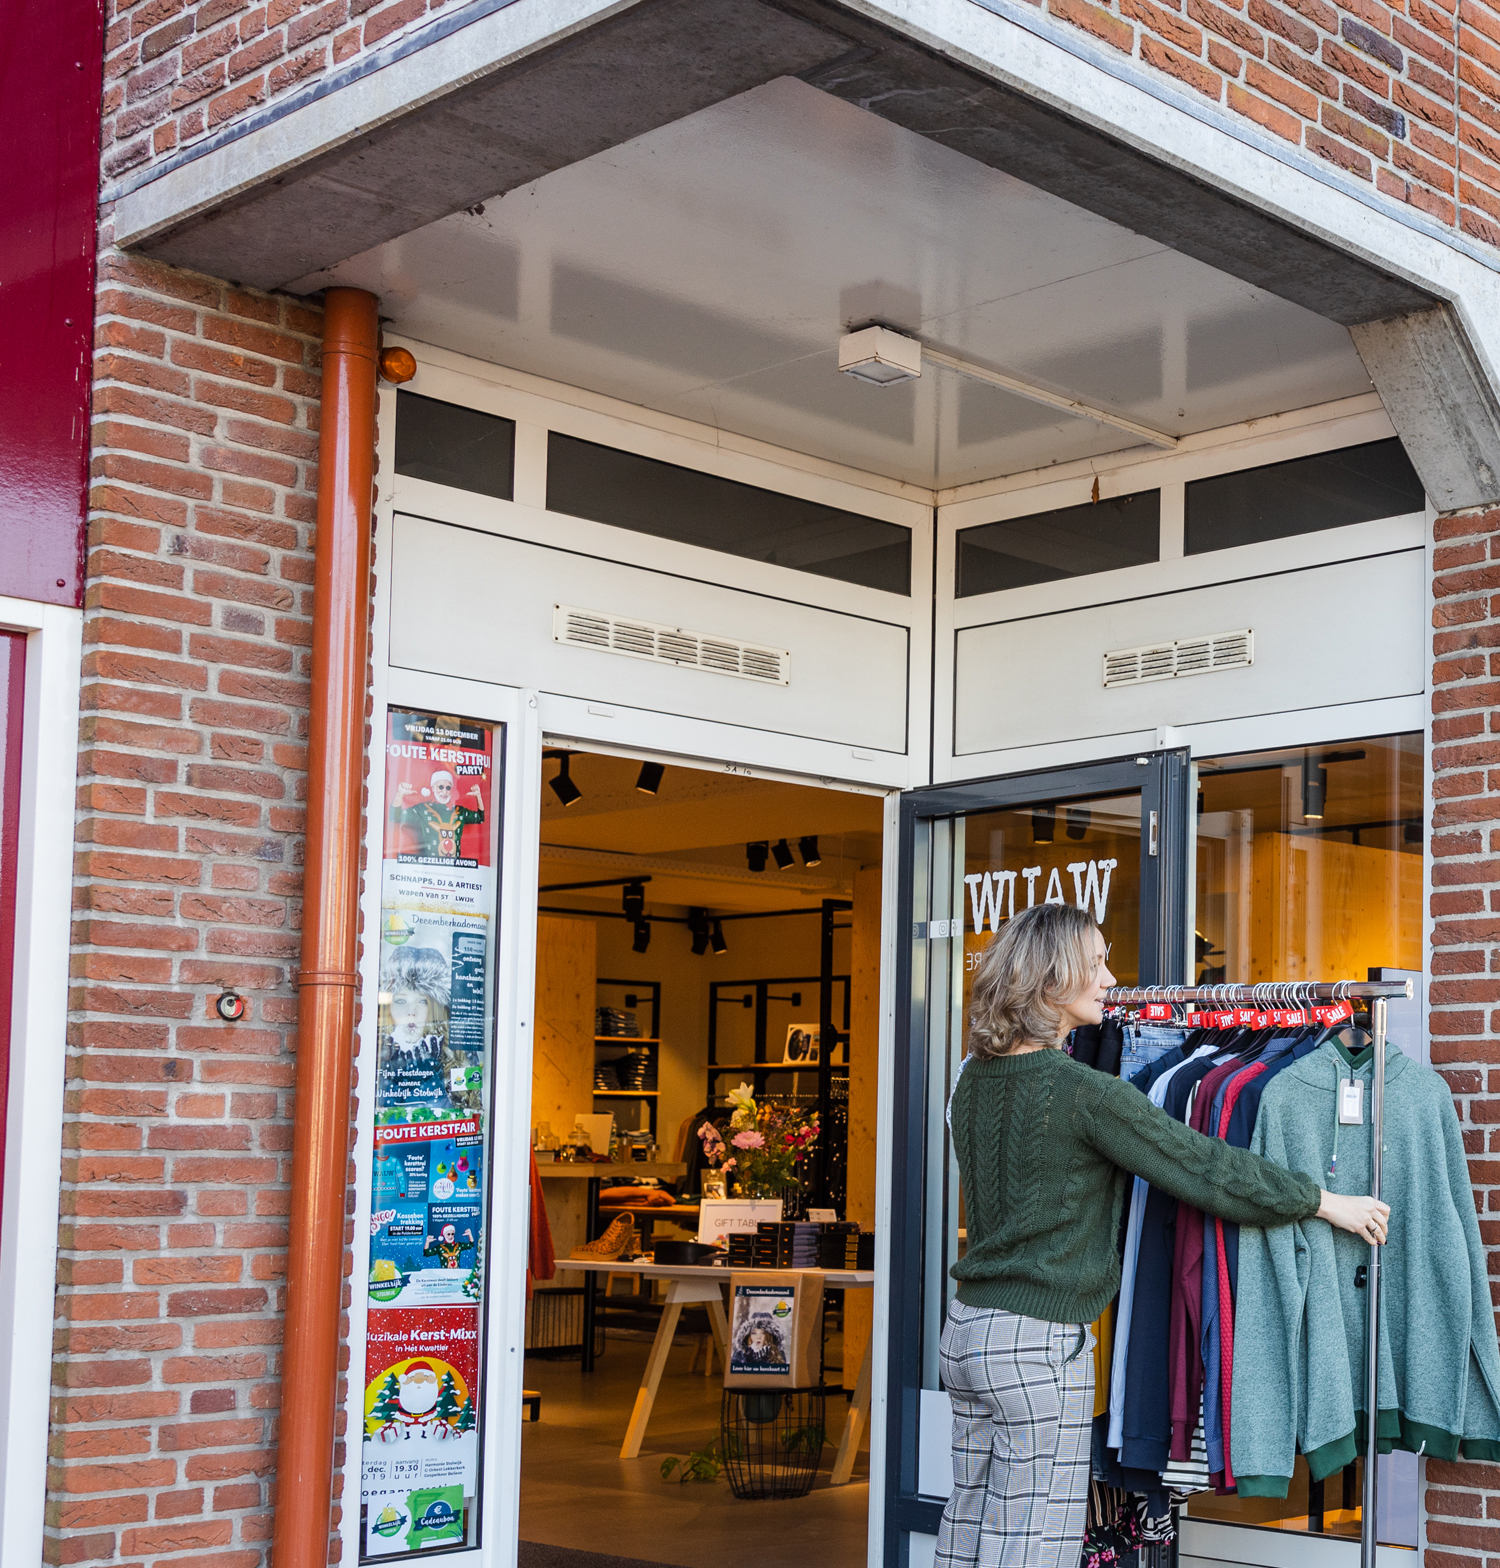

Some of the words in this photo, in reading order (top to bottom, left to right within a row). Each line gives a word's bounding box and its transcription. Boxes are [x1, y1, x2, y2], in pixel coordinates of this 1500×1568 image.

[405, 725, 434, 734] VRIJDAG
[436, 728, 444, 736] 13
[445, 730, 478, 740] DECEMBER
[457, 766, 482, 774] PARTY
[418, 857, 454, 865] GEZELLIGE
[390, 874, 435, 886] SCHNAPPS,
[456, 882, 482, 891] ARTIEST
[1150, 1006, 1165, 1017] SALE
[1327, 1006, 1346, 1023] SALE
[1286, 1012, 1302, 1025] SALE
[377, 1069, 396, 1079] Fijne
[397, 1068, 434, 1078] Feestdagen
[413, 1088, 443, 1098] Stolwijk
[376, 1127, 417, 1140] FOUTE
[419, 1122, 475, 1136] KERSTFAIR
[714, 1218, 735, 1227] GIFT
[410, 1329, 476, 1340] Kerst-Mixx
[434, 1506, 442, 1514] €
[421, 1514, 454, 1525] Cadeaubon
